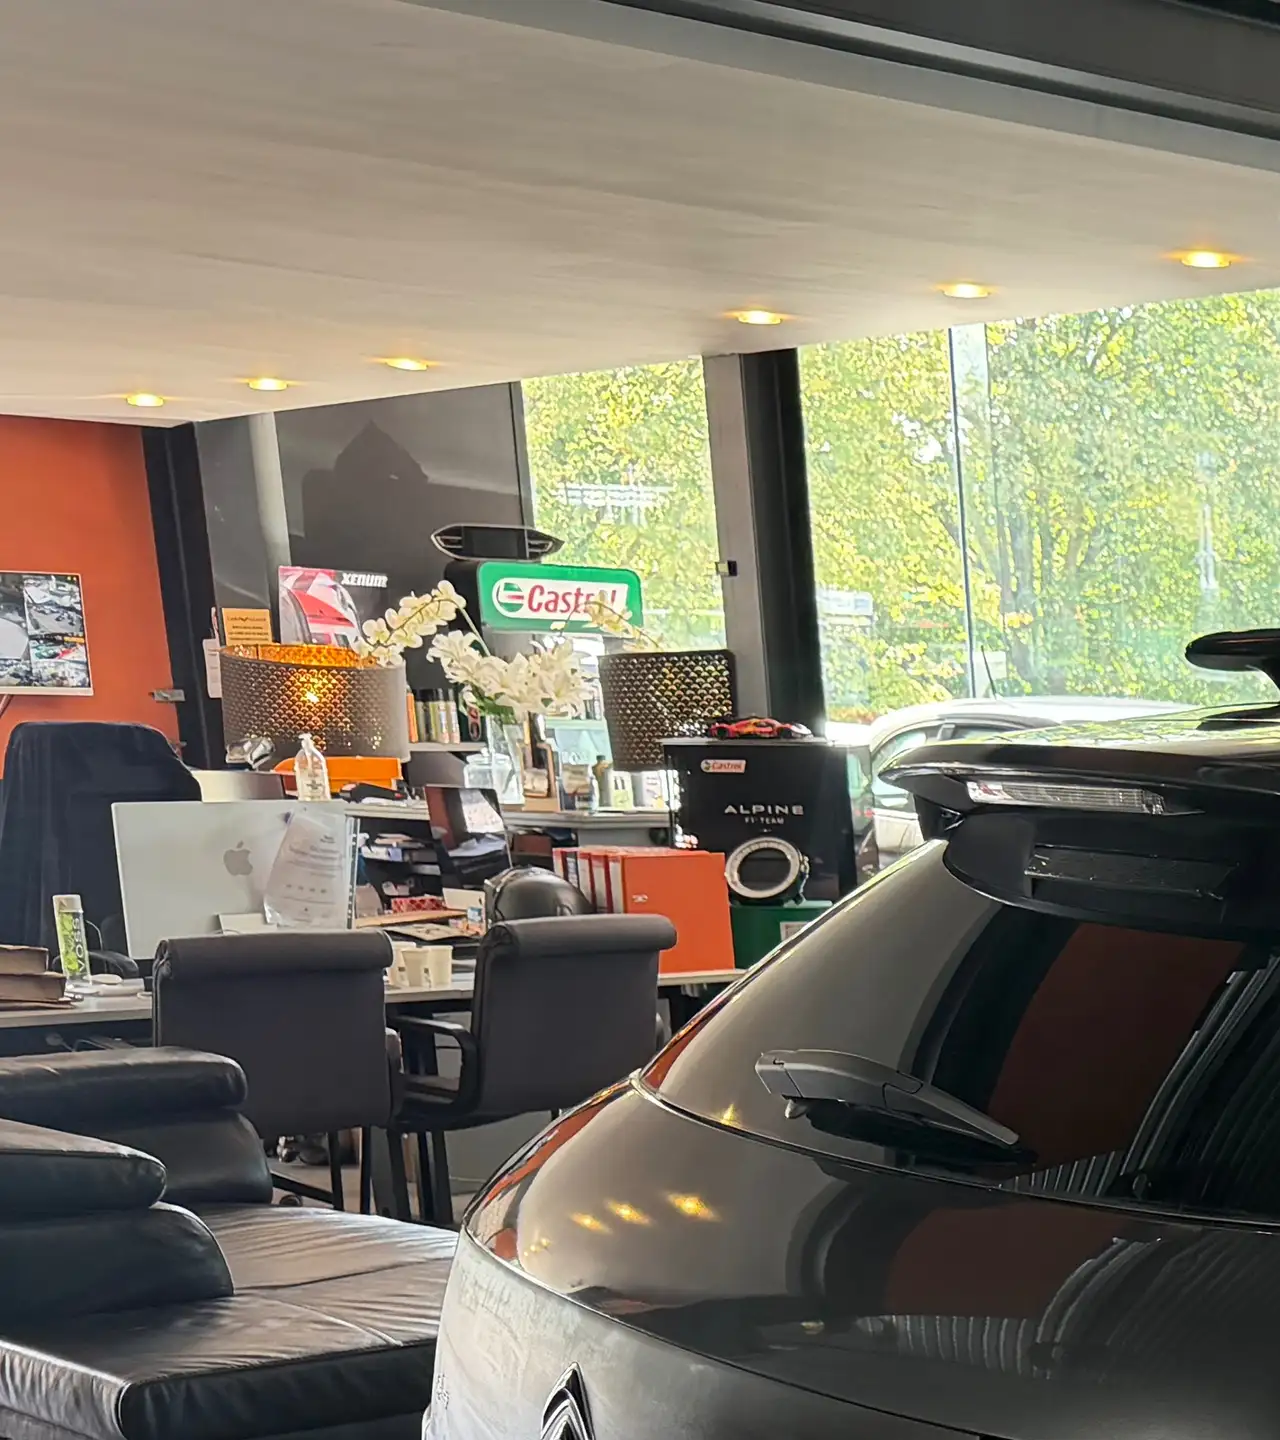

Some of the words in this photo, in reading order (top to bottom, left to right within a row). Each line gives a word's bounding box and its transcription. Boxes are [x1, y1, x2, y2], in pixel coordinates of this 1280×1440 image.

[527, 584, 617, 614] Castrl
[724, 805, 804, 815] ALPINE
[72, 917, 85, 972] VOSS
